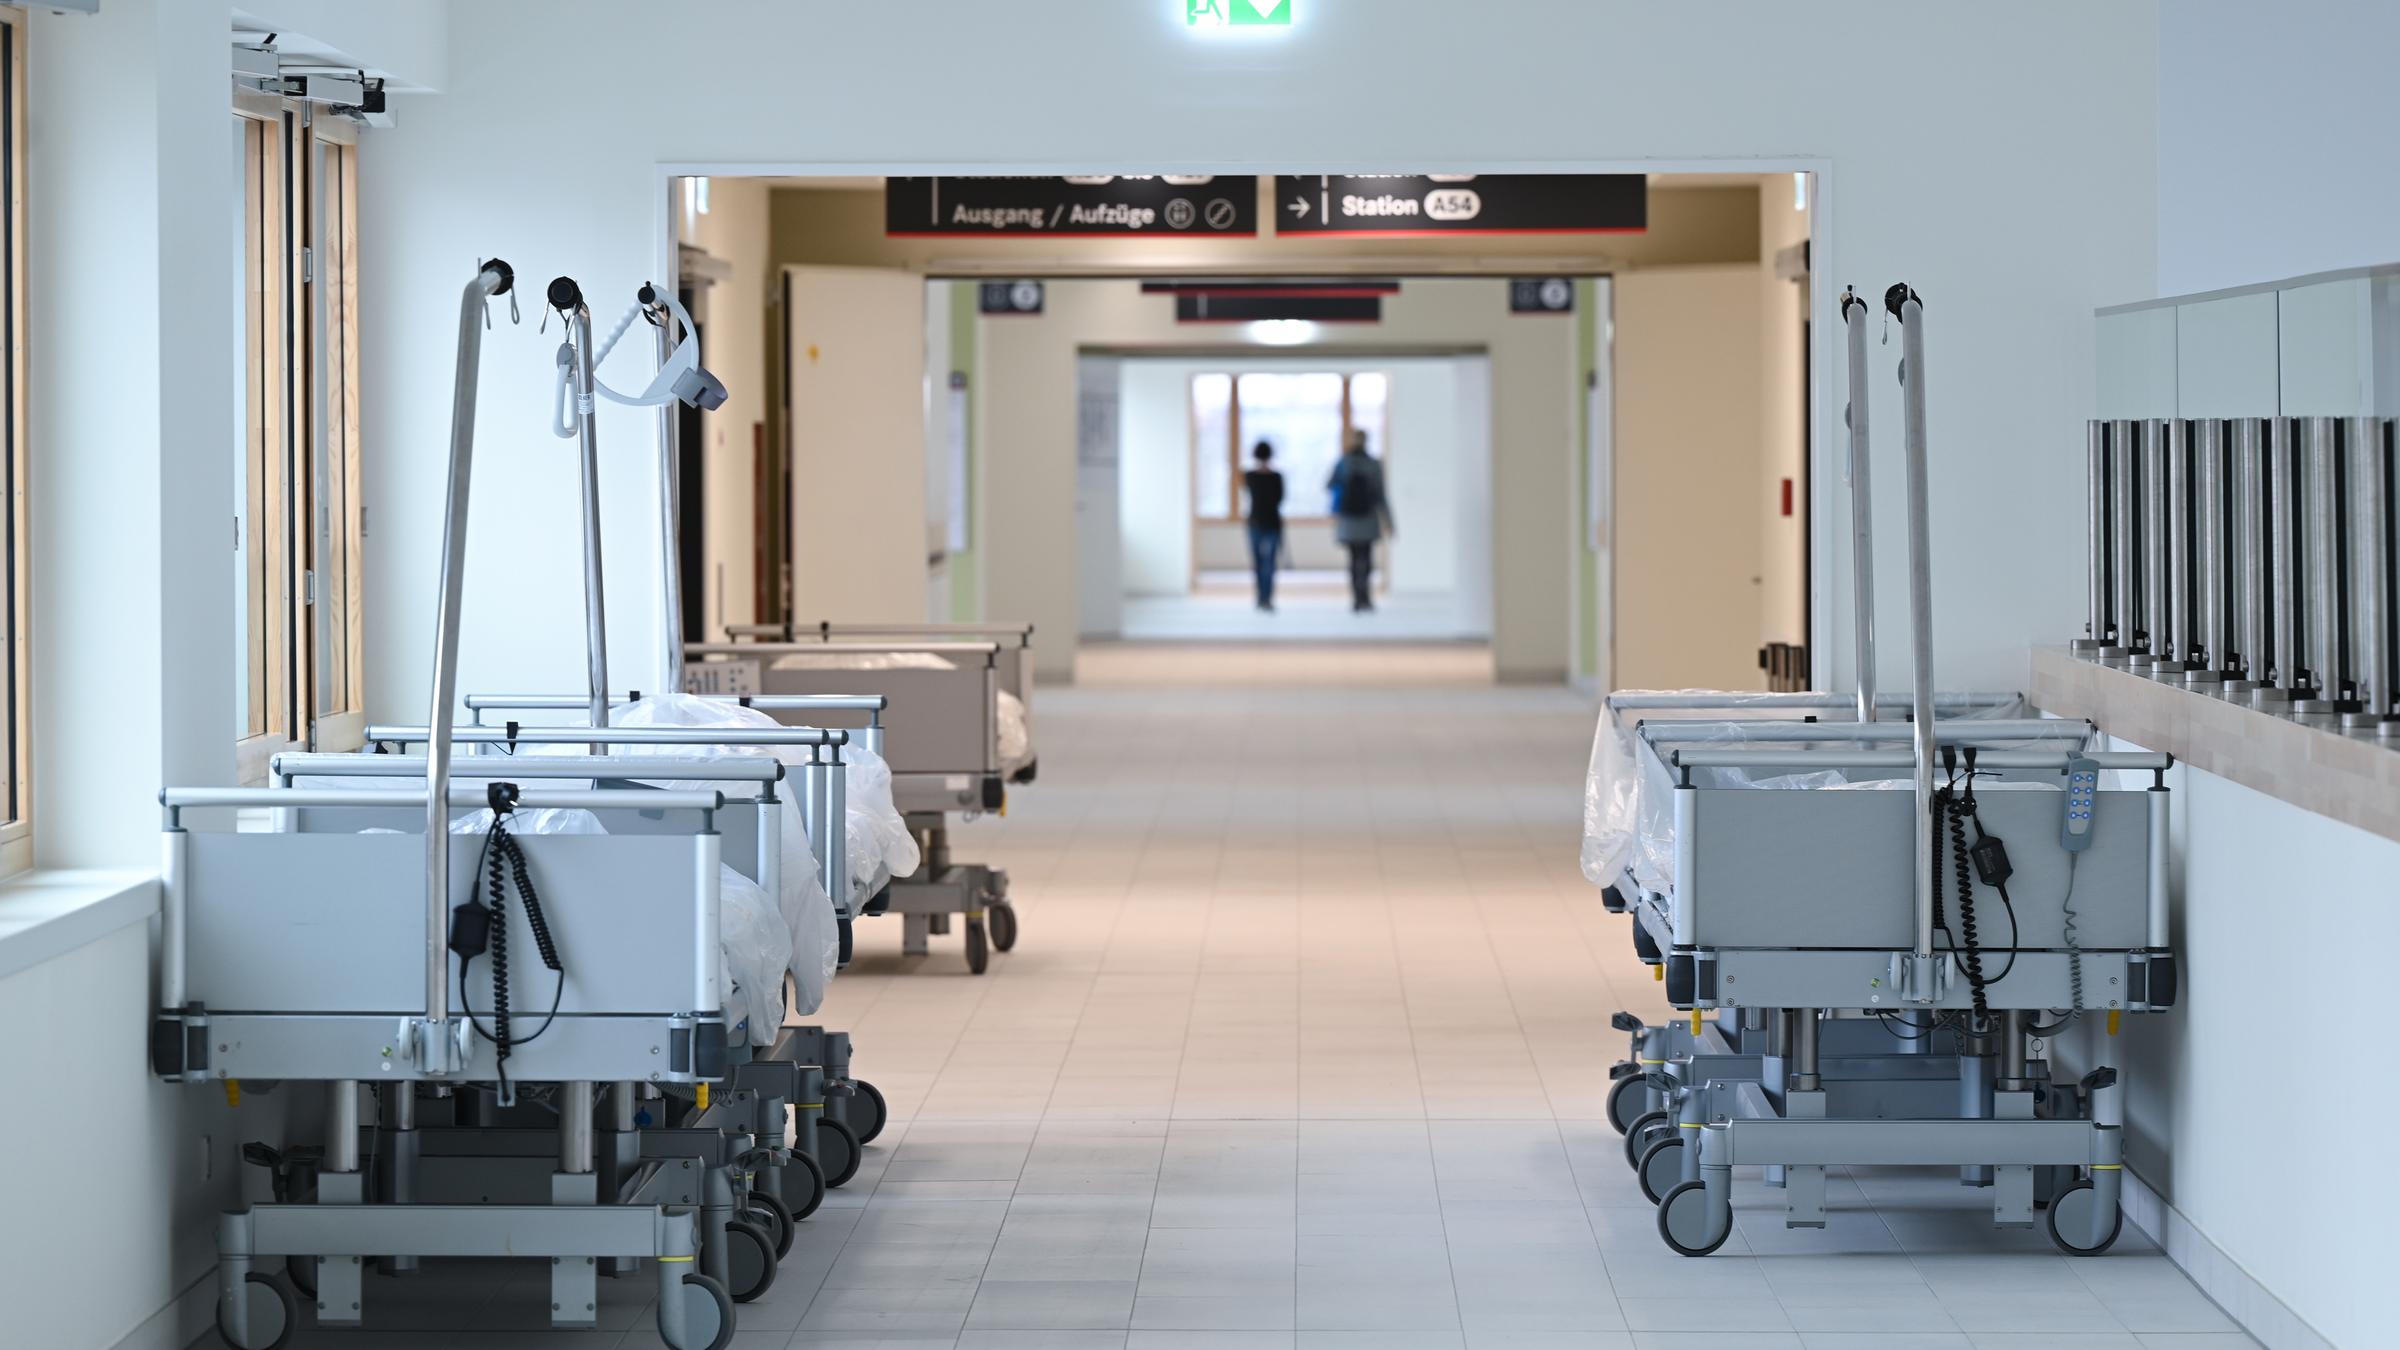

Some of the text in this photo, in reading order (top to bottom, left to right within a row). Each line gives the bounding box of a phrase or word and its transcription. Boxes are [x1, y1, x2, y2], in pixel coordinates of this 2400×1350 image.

[952, 203, 1156, 229] Ausgang / Aufzüge
[1342, 194, 1472, 217] Station A54
